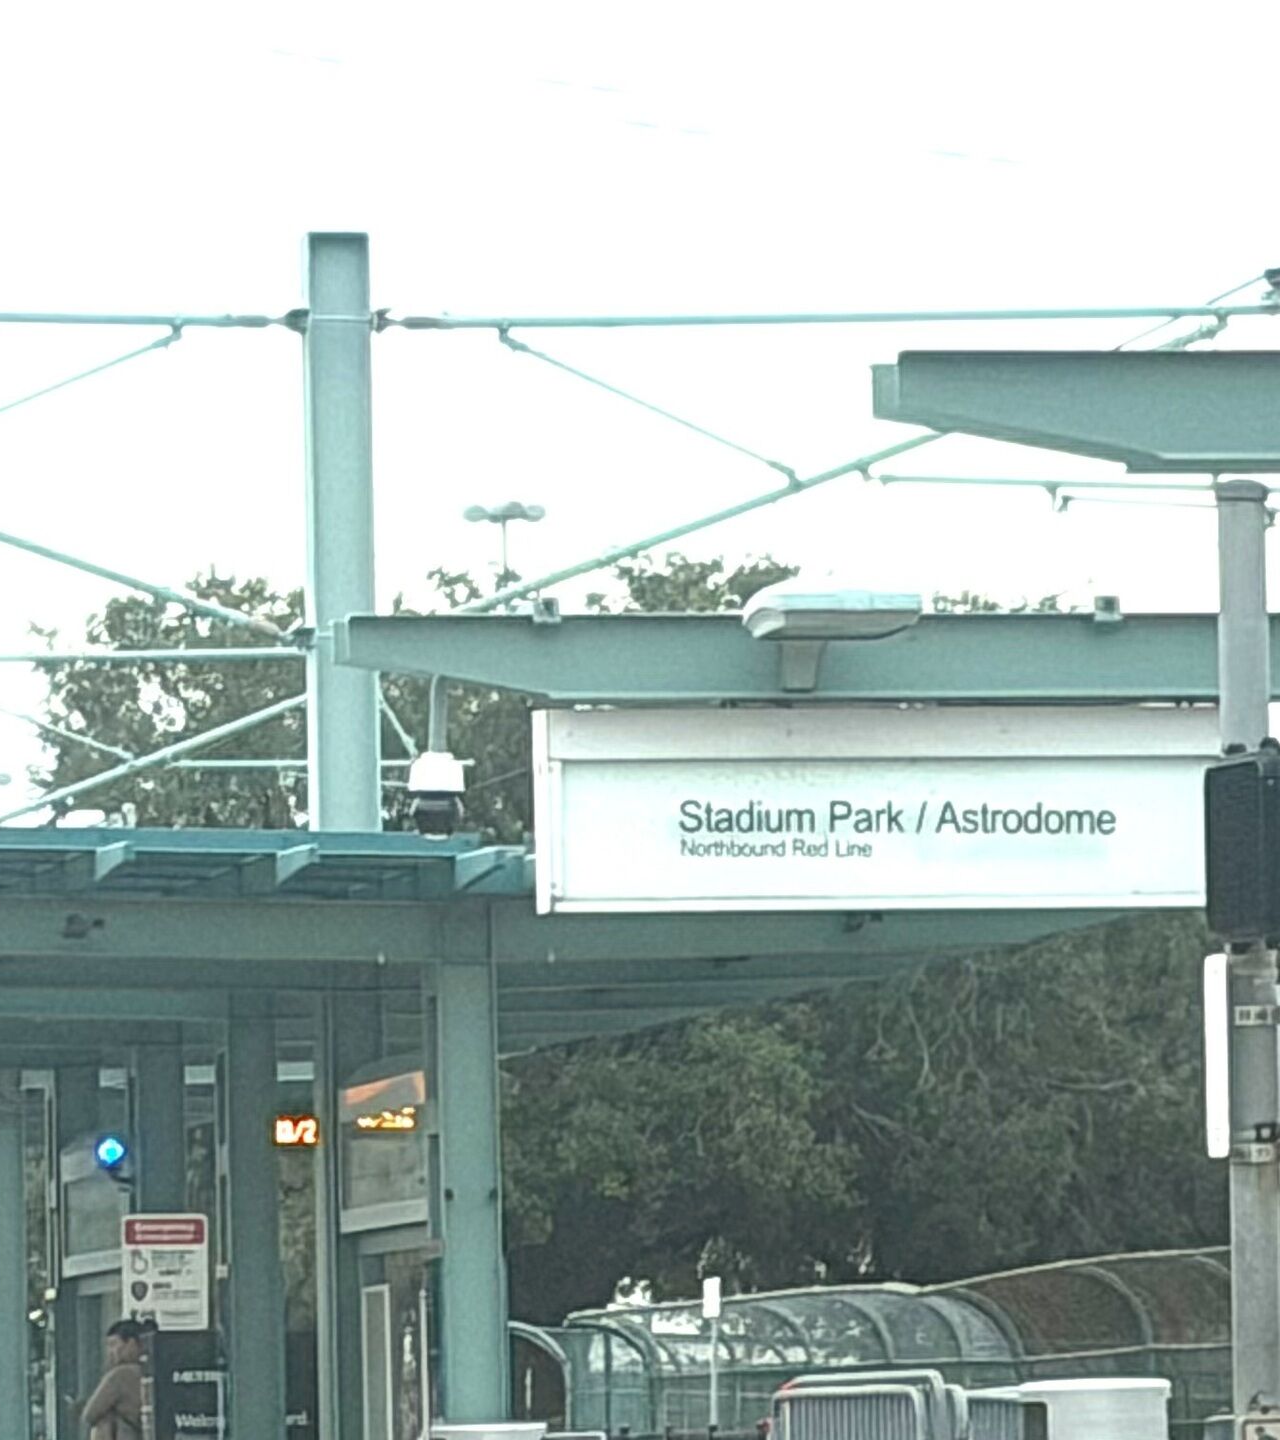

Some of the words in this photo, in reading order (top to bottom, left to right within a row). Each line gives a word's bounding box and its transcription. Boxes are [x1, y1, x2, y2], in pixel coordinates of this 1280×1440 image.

[679, 799, 816, 834] Stadium
[828, 799, 905, 834] Park
[915, 800, 928, 834] /
[935, 800, 1117, 836] Astrodome
[680, 838, 786, 858] Northbound
[792, 837, 829, 858] Red
[835, 839, 873, 858] Line
